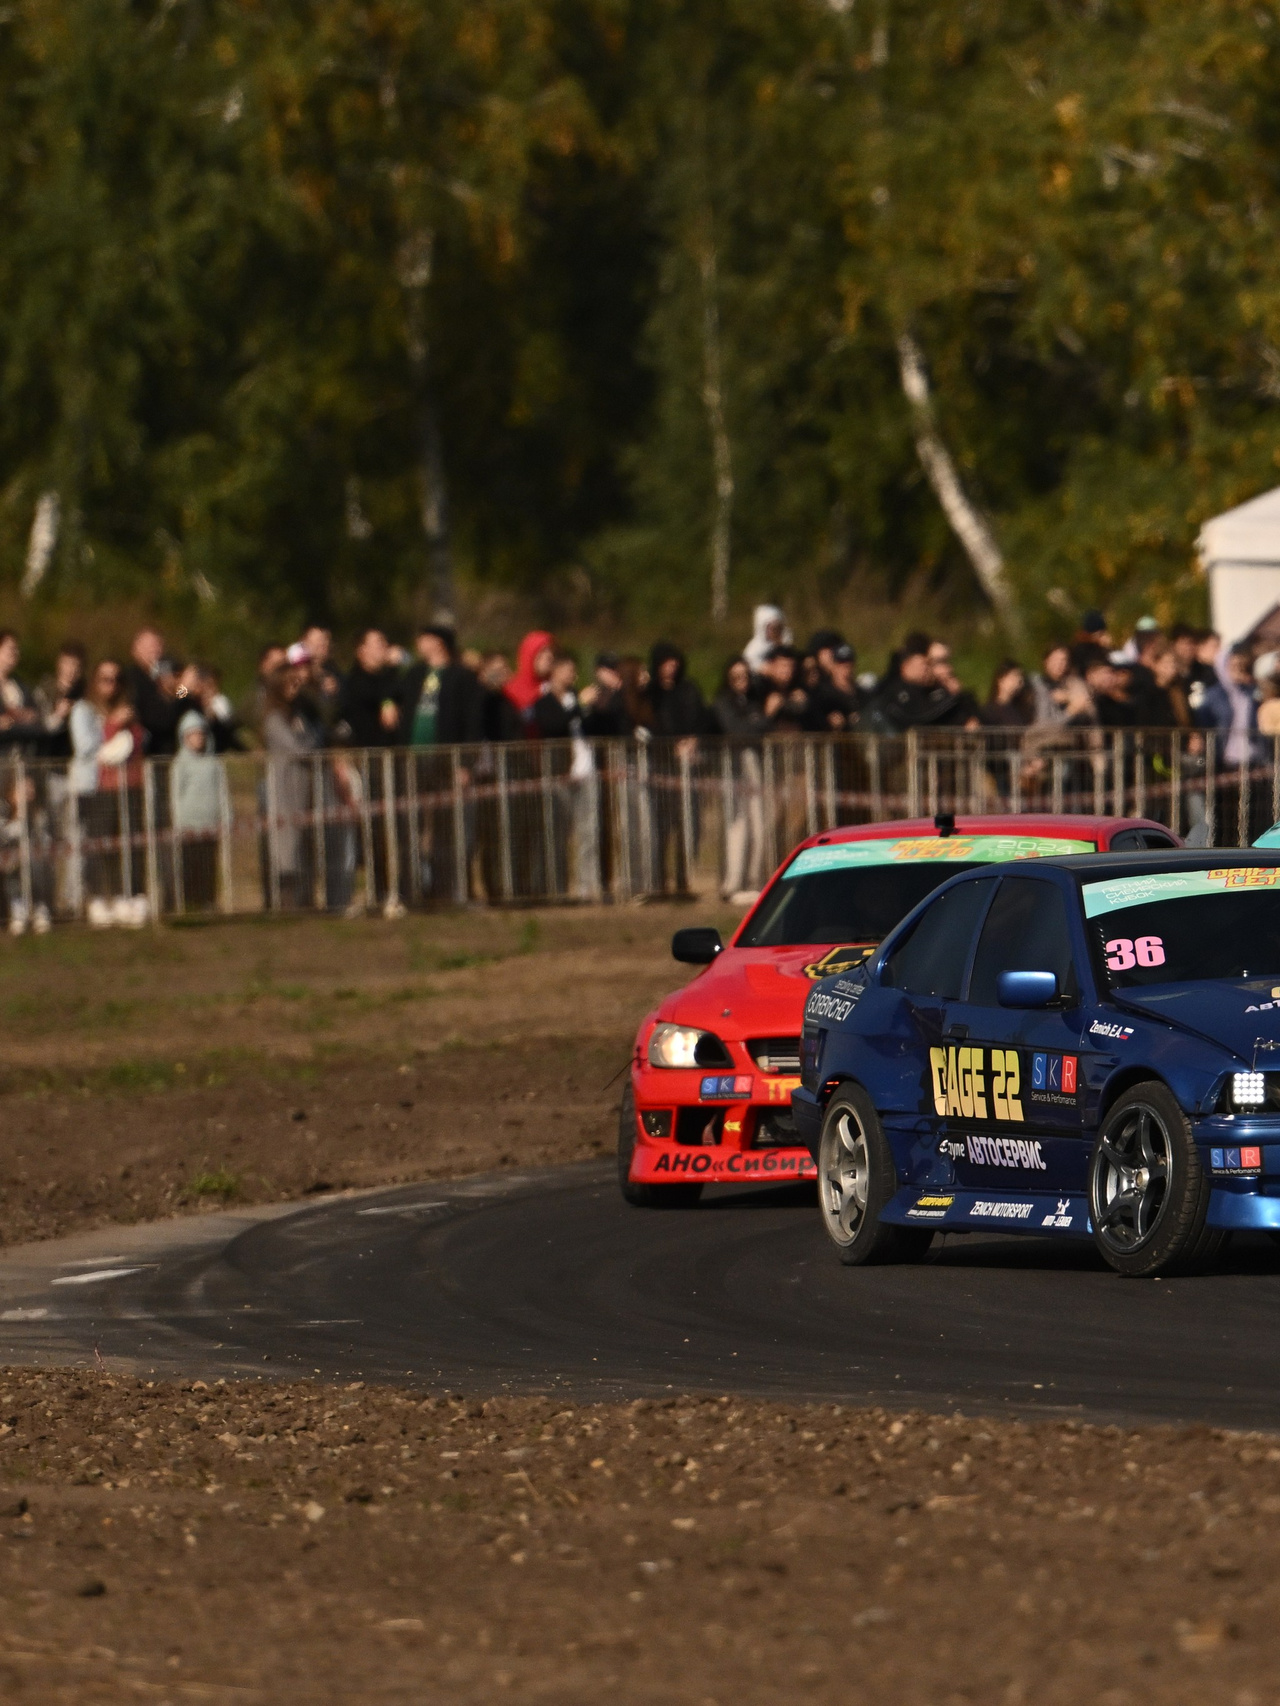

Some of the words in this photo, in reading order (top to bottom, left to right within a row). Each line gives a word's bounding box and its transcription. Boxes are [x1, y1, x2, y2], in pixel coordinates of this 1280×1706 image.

[997, 840, 1072, 854] 2024
[1101, 878, 1157, 894] ЛЕТНИЙ
[1105, 879, 1188, 899] СИБИРСКИЙ
[1109, 890, 1155, 905] КУБОК
[1105, 936, 1166, 971] 36
[1034, 1056, 1075, 1089] SKR
[703, 1077, 748, 1092] SKR
[991, 1049, 1025, 1122] 22
[966, 1135, 1047, 1170] АВТОСЕРВИС
[1213, 1148, 1258, 1167] SKR
